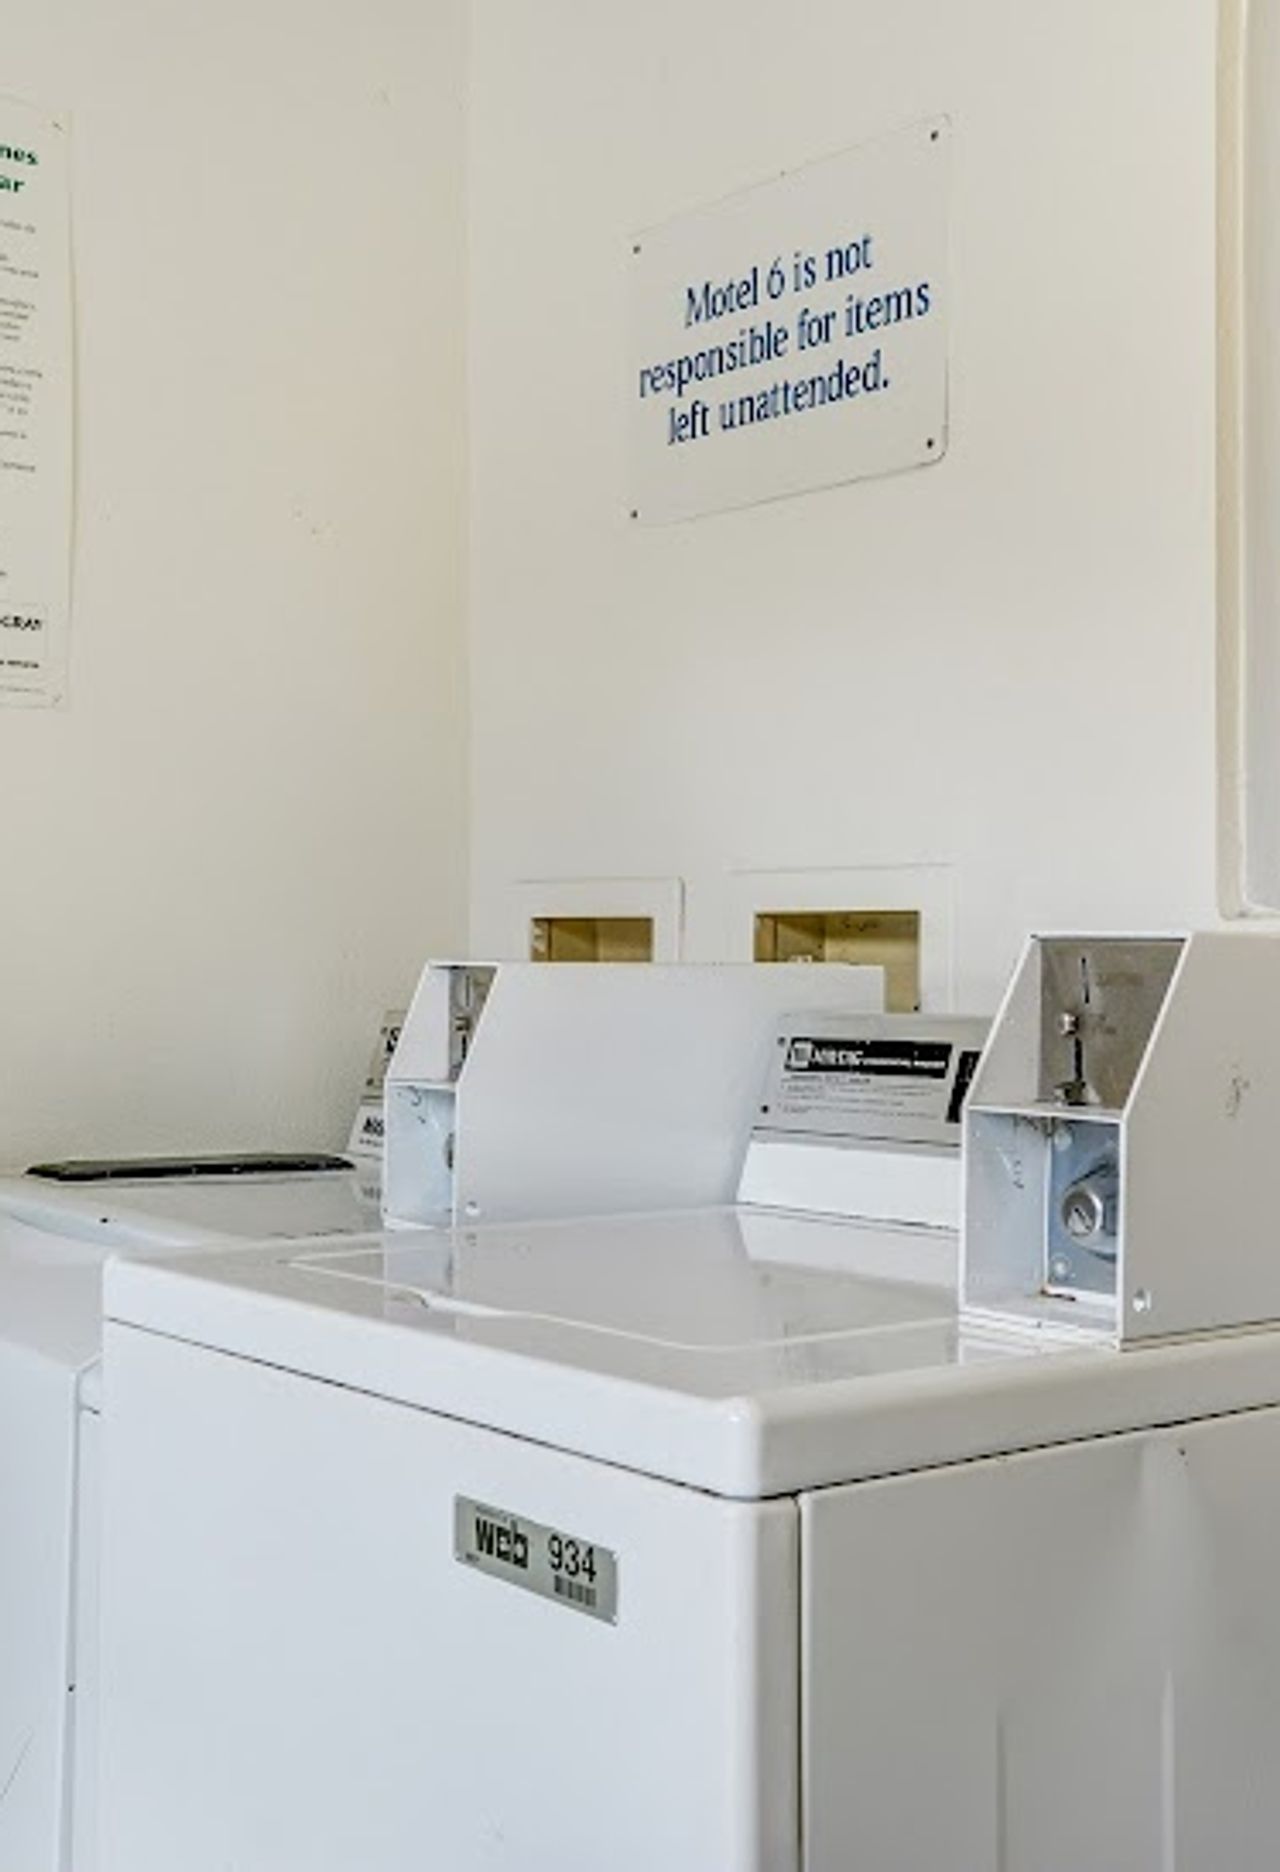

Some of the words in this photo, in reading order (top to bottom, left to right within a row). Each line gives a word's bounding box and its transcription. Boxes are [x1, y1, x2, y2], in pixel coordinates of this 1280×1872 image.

[684, 266, 758, 328] Motel
[767, 257, 785, 299] 6
[793, 252, 816, 291] is
[825, 235, 872, 281] not
[640, 321, 788, 397] responsible
[797, 308, 835, 351] for
[845, 283, 930, 336] items
[668, 400, 709, 445] left
[719, 349, 889, 430] unattended.
[548, 1534, 597, 1582] 934
